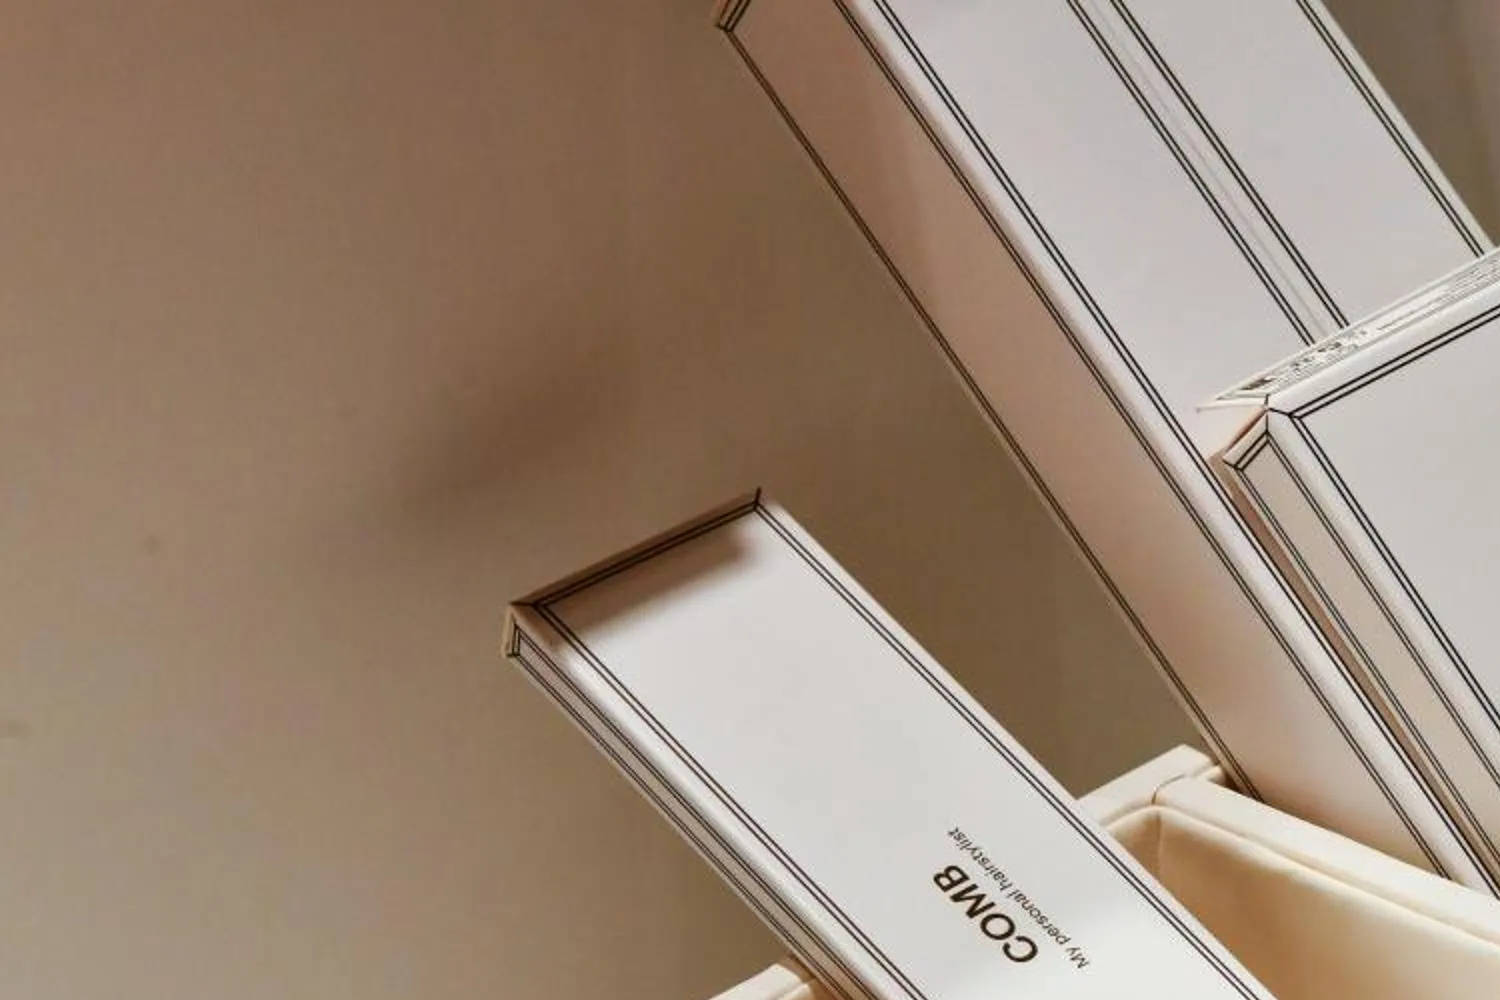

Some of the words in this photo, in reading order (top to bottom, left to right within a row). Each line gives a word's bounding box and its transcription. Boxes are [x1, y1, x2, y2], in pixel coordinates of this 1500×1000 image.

[947, 826, 1013, 891] hairstylist
[933, 865, 1039, 963] COMB
[1007, 889, 1072, 945] personal
[1066, 946, 1090, 969] My
